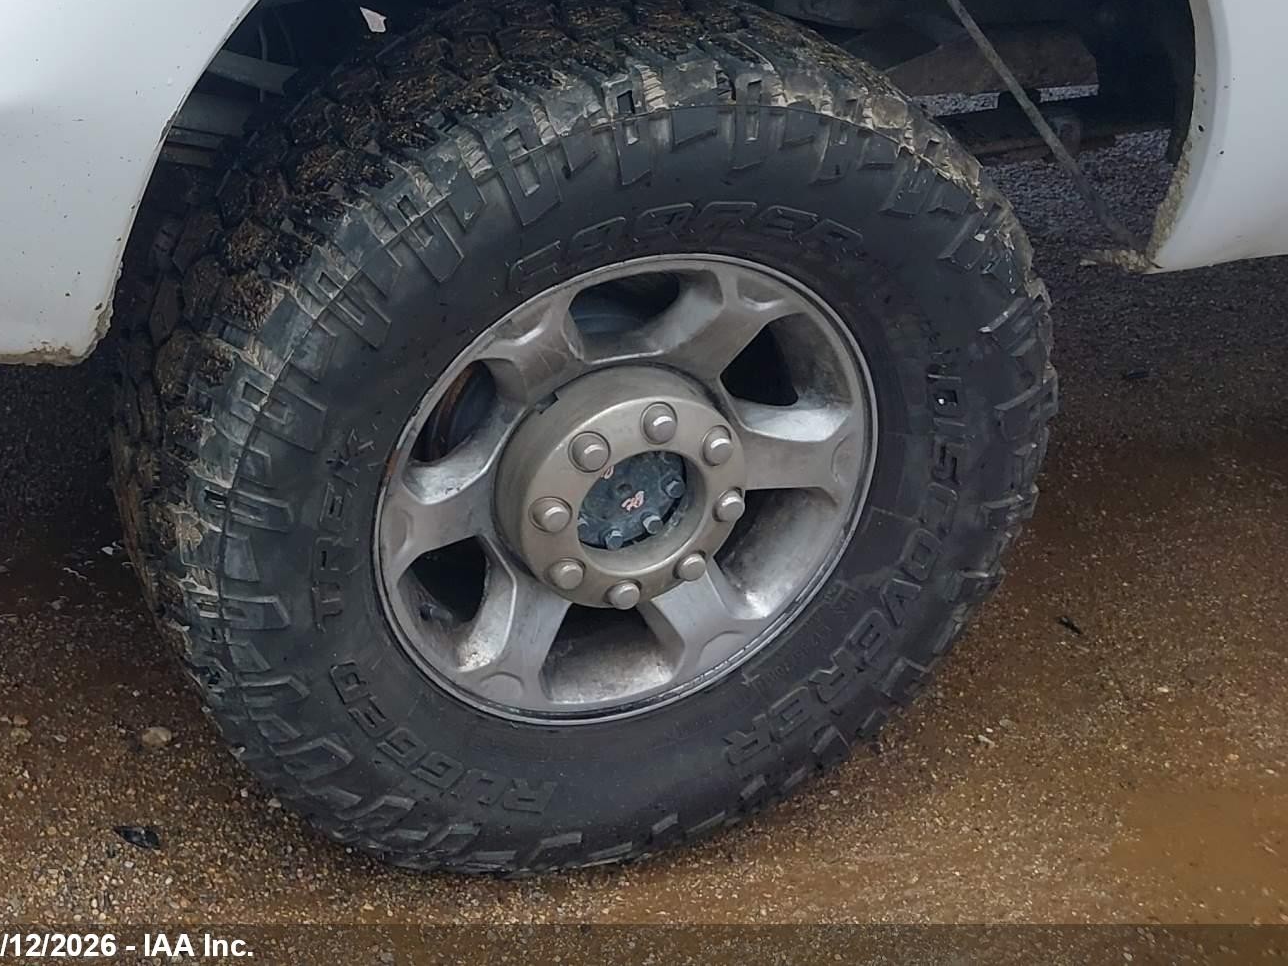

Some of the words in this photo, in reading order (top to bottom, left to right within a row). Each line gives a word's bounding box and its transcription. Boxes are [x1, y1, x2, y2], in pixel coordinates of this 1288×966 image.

[312, 428, 376, 632] TREK
[721, 371, 970, 768] DISCOVERER
[328, 660, 559, 815] RUGGED
